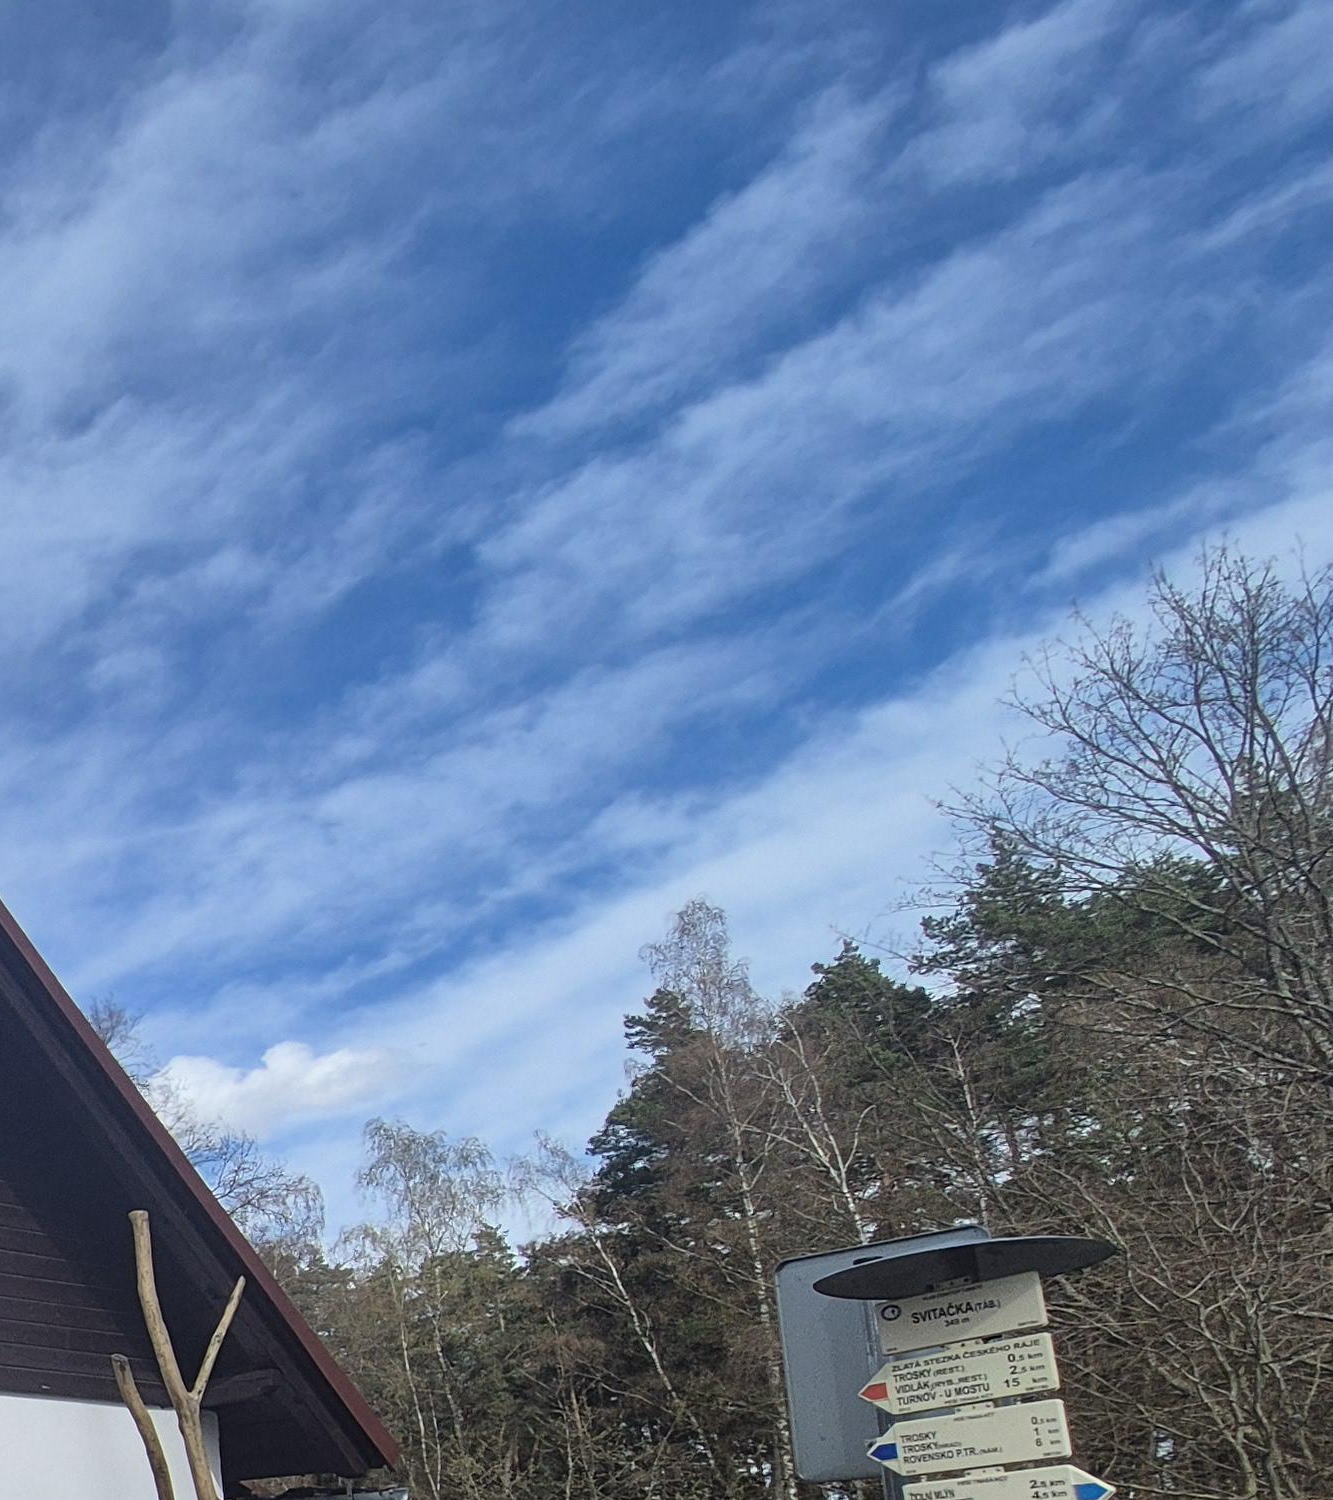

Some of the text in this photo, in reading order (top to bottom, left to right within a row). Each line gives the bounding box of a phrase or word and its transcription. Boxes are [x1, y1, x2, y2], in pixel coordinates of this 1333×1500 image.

[911, 1302, 974, 1324] SVITAČKA
[891, 1339, 1040, 1372] ZLATÁ STEZKA ČESKÉHO RÁJE
[893, 1367, 932, 1383] TROSKY
[897, 1392, 936, 1406] TURNOV
[944, 1389, 951, 1398] U
[954, 1382, 990, 1396] MOSTU
[1004, 1377, 1021, 1388] 15
[900, 1431, 937, 1443] TROSKY
[1034, 1428, 1040, 1436] 1
[904, 1450, 954, 1464] ROVENSKO
